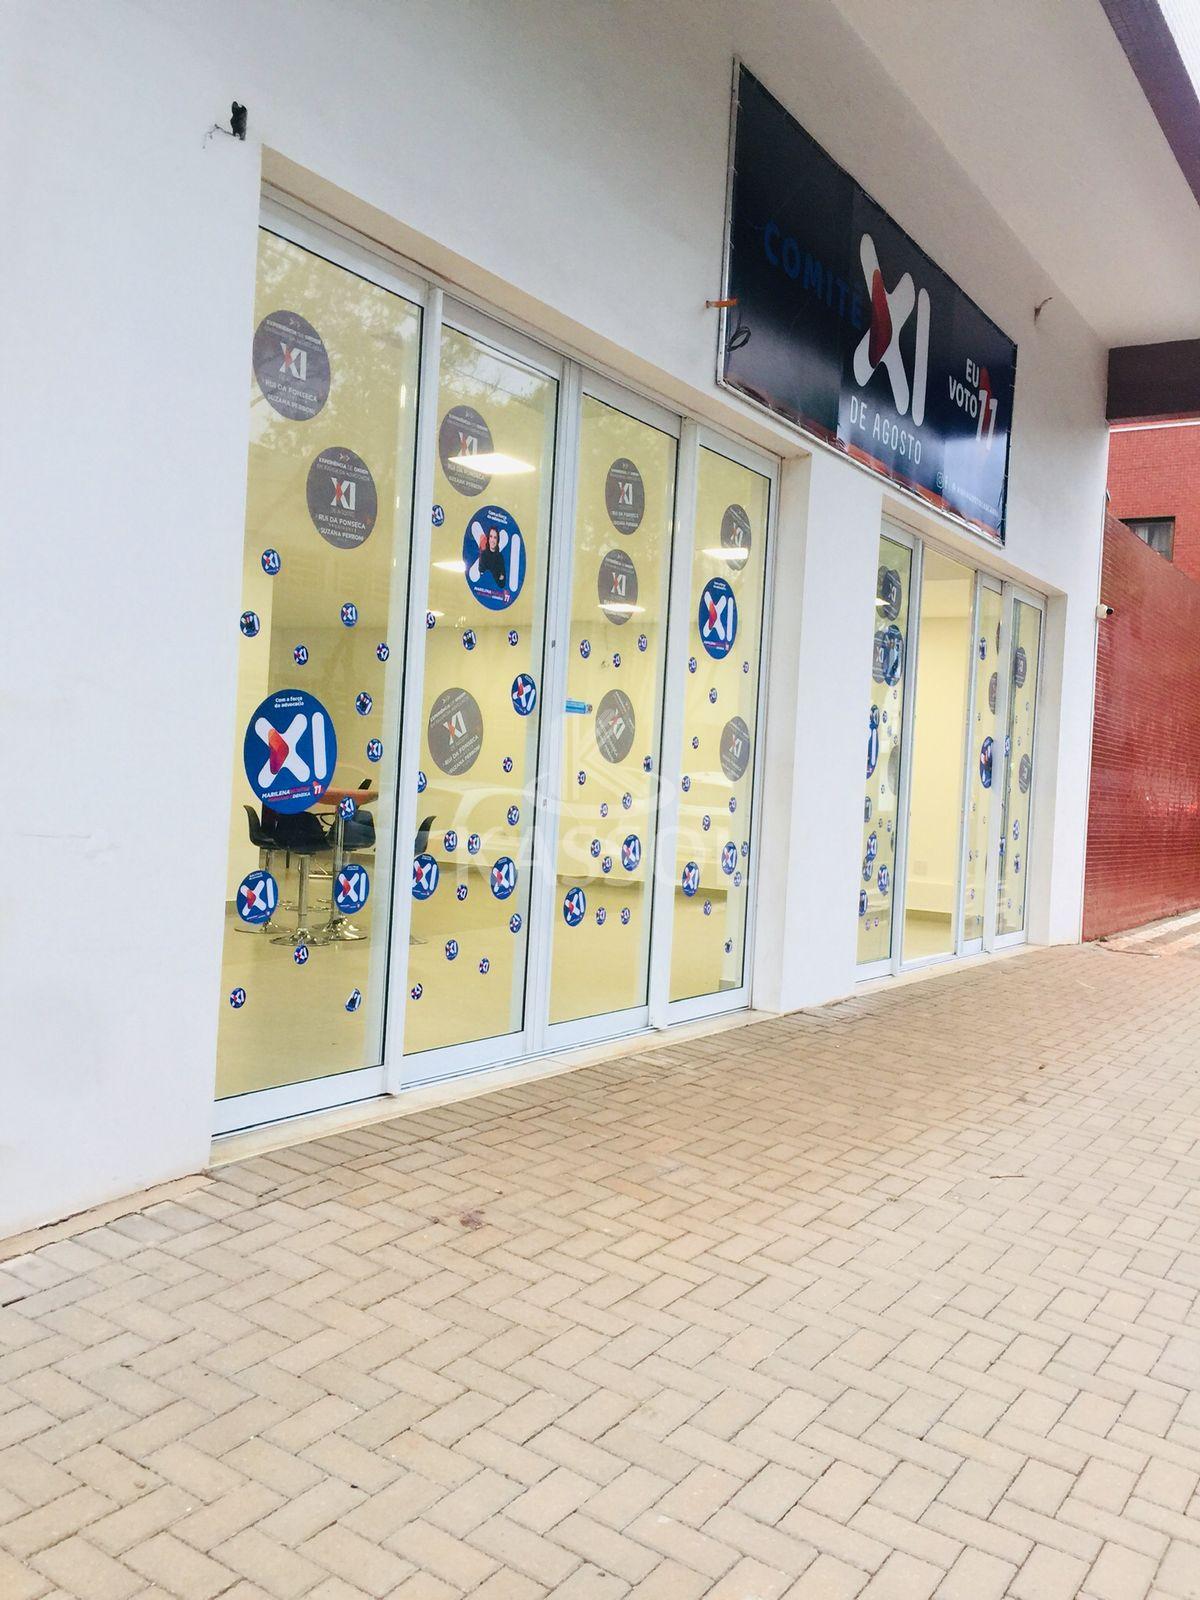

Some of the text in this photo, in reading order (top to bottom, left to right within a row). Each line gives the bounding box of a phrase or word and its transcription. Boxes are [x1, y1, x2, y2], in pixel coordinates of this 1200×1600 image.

[853, 232, 931, 427] XI
[966, 358, 980, 388] EU
[949, 375, 978, 418] VOTO
[850, 395, 921, 465] DE AGOSTO
[330, 477, 356, 511] XI
[339, 518, 366, 530] FONSECA
[702, 591, 734, 642] XI
[254, 711, 327, 789] XI
[240, 877, 275, 917] XI
[337, 872, 366, 904] XI
